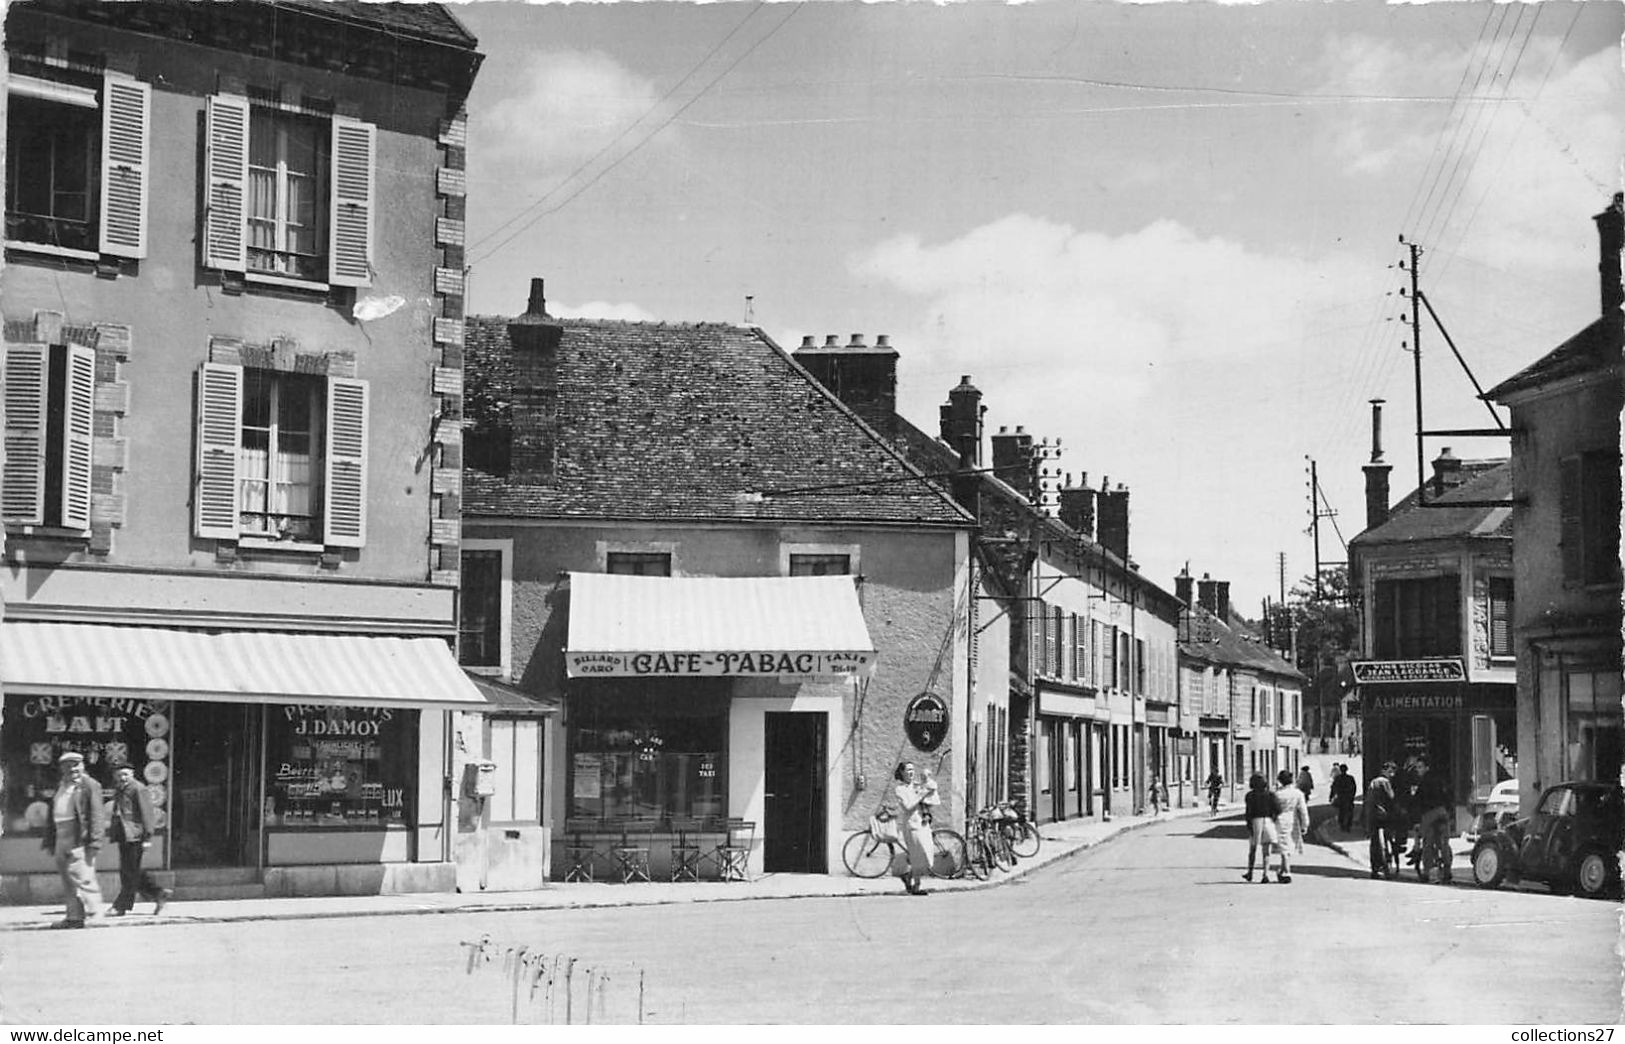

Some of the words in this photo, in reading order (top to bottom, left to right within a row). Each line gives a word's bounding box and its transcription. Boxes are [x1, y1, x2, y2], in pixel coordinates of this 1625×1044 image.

[574, 655, 621, 665] BILLARD
[631, 652, 813, 674] CAFE-TABAC
[825, 653, 867, 664] TAXIS
[581, 665, 614, 673] CARO
[1374, 696, 1463, 708] ALIMENTATION
[284, 705, 393, 721] PRITS
[382, 788, 403, 806] LUX
